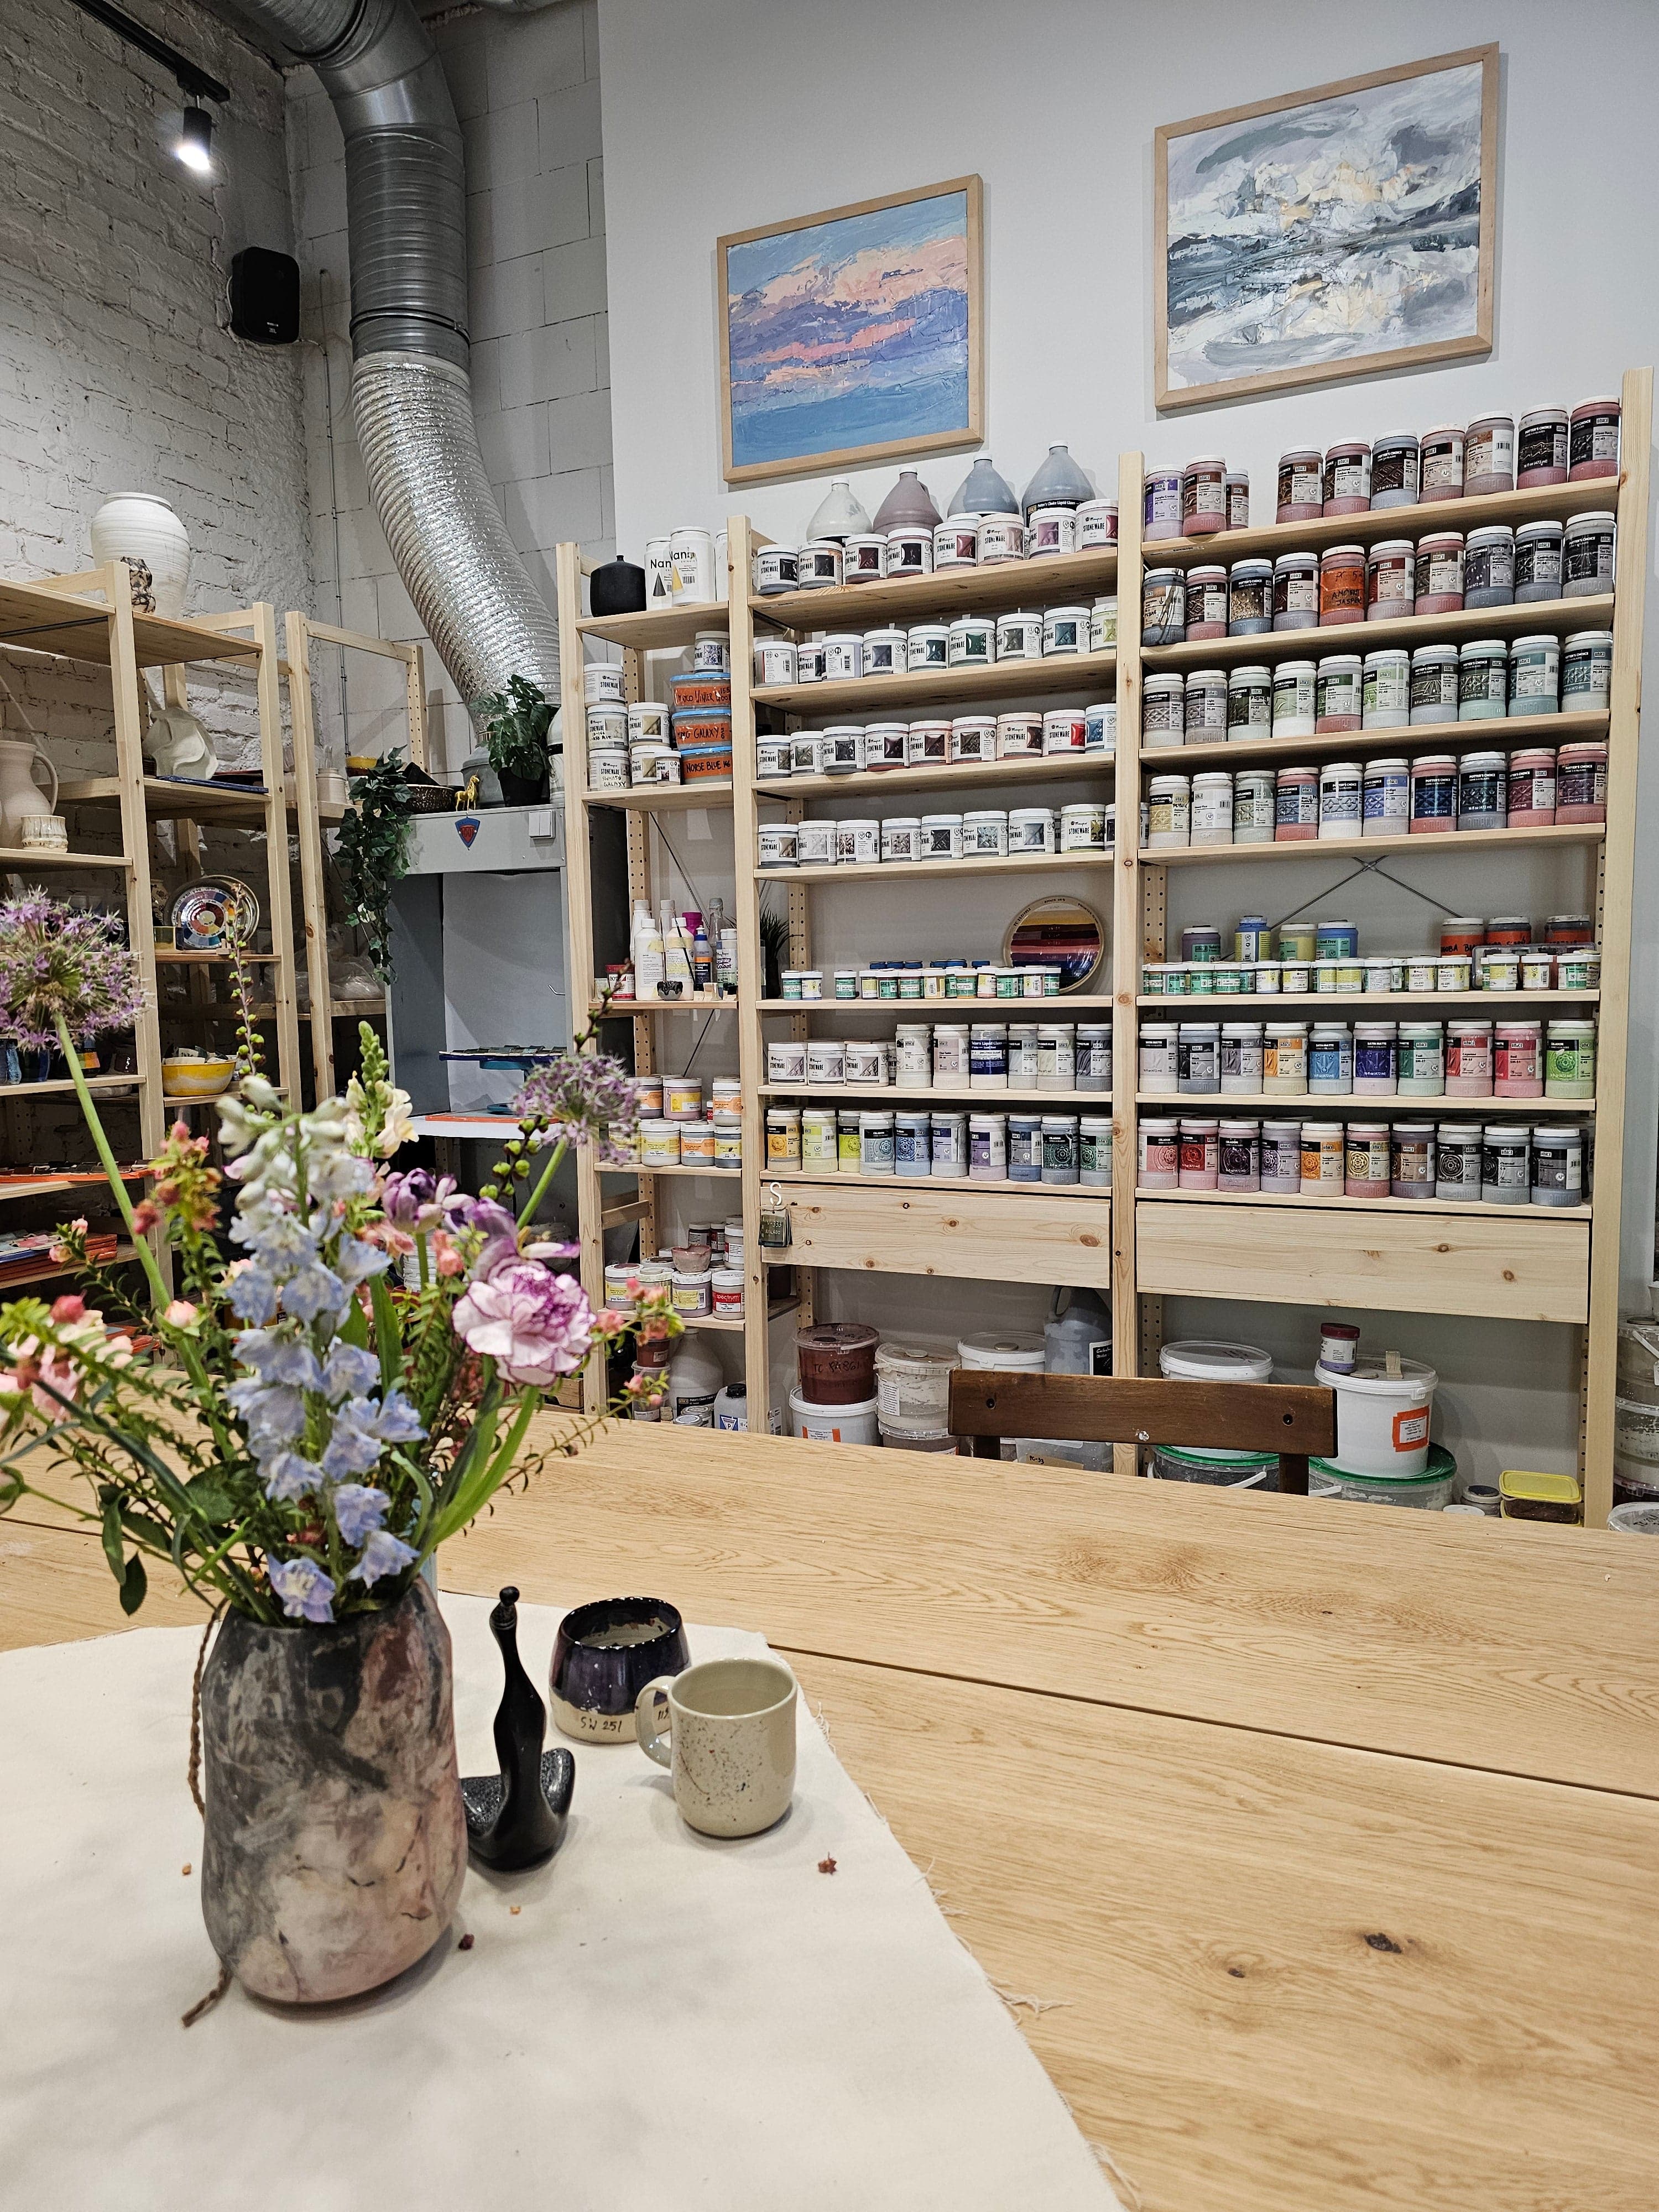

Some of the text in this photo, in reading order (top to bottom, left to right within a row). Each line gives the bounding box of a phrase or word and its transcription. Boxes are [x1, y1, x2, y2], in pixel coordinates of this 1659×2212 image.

[1083, 522, 1104, 532] STONEWARE
[985, 535, 1005, 544] STONEWARE
[937, 542, 956, 552] STONEWARE
[761, 566, 778, 574] STONEWARE
[694, 727, 718, 738] GALAXY
[686, 763, 705, 773] NORSE
[707, 761, 721, 770] BLUE
[581, 1717, 622, 1733] SW 251
